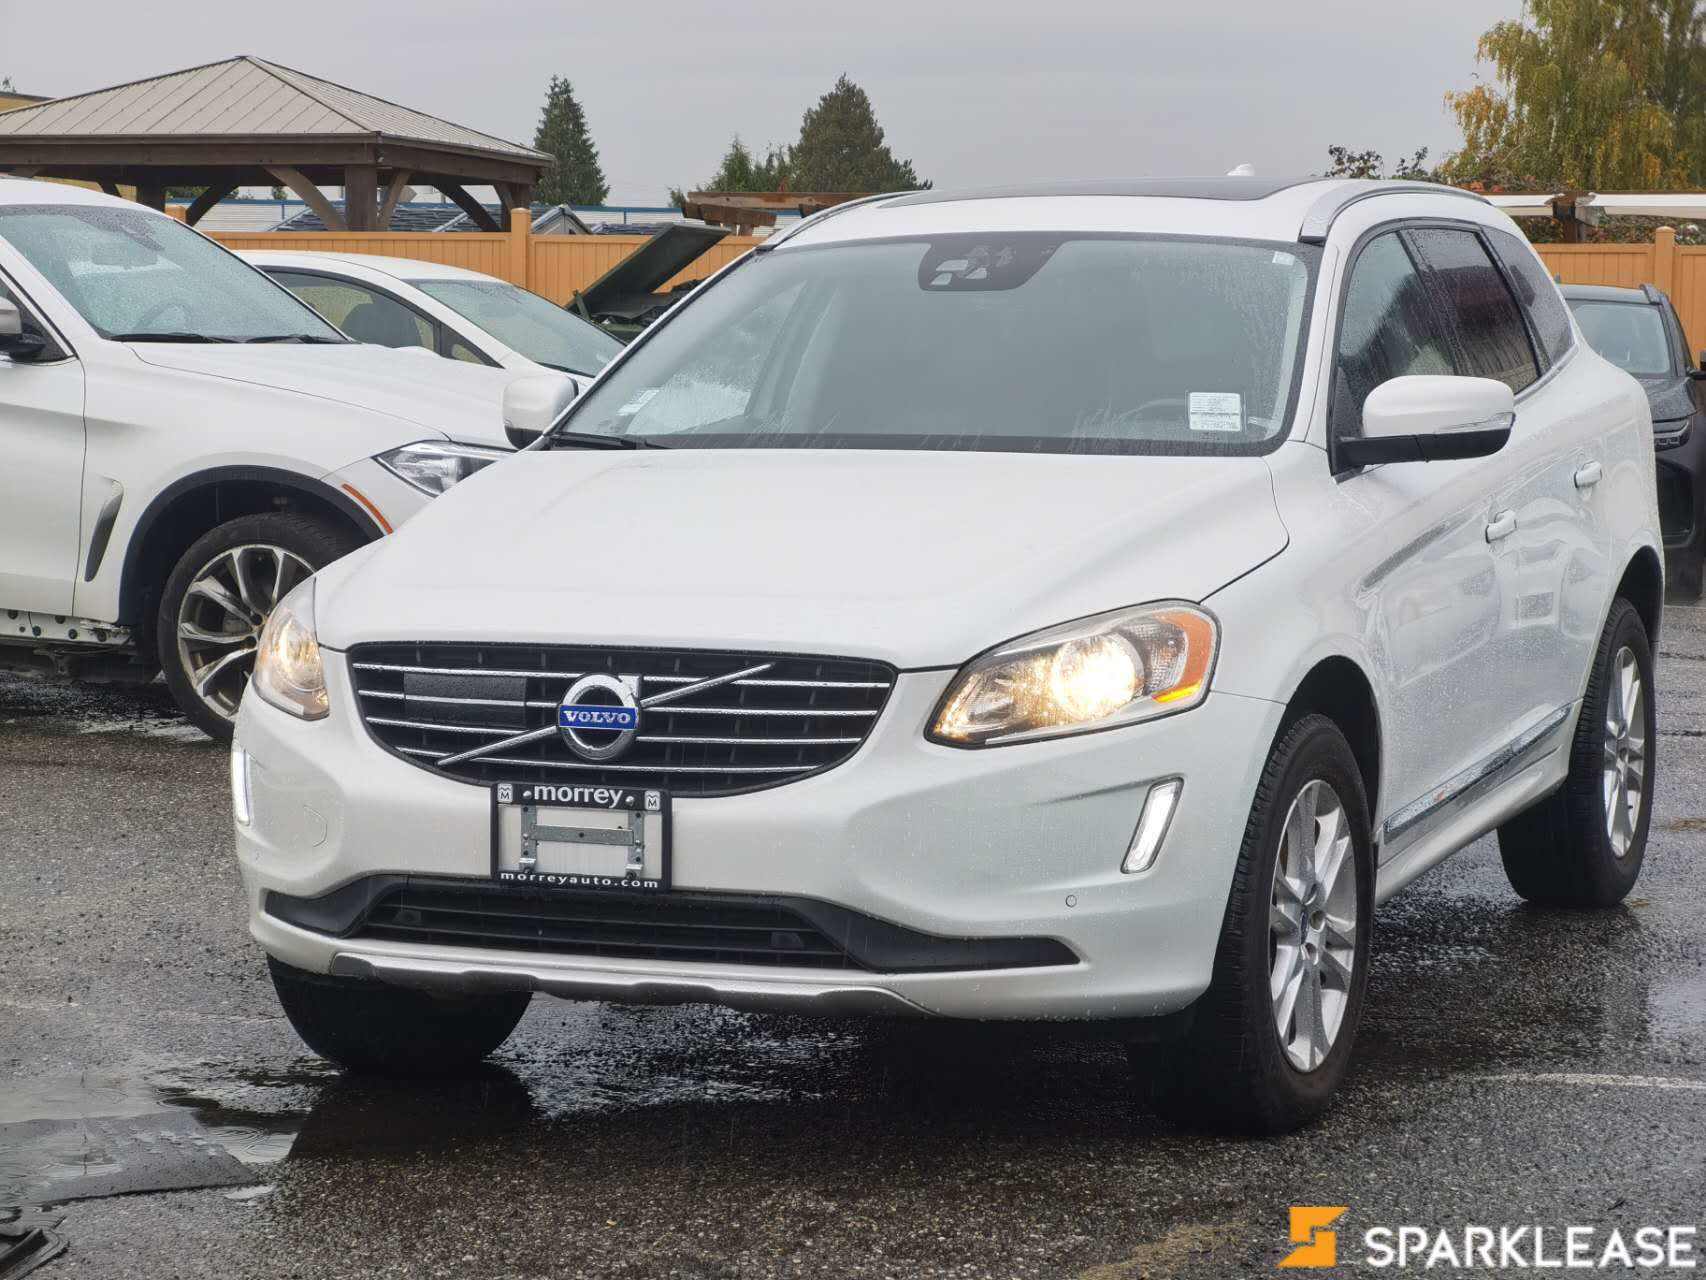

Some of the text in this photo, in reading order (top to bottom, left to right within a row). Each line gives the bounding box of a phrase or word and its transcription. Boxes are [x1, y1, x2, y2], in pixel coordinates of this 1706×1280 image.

[563, 710, 631, 724] VOLVO
[533, 785, 623, 808] morrey
[500, 872, 658, 888] morreyauto.com
